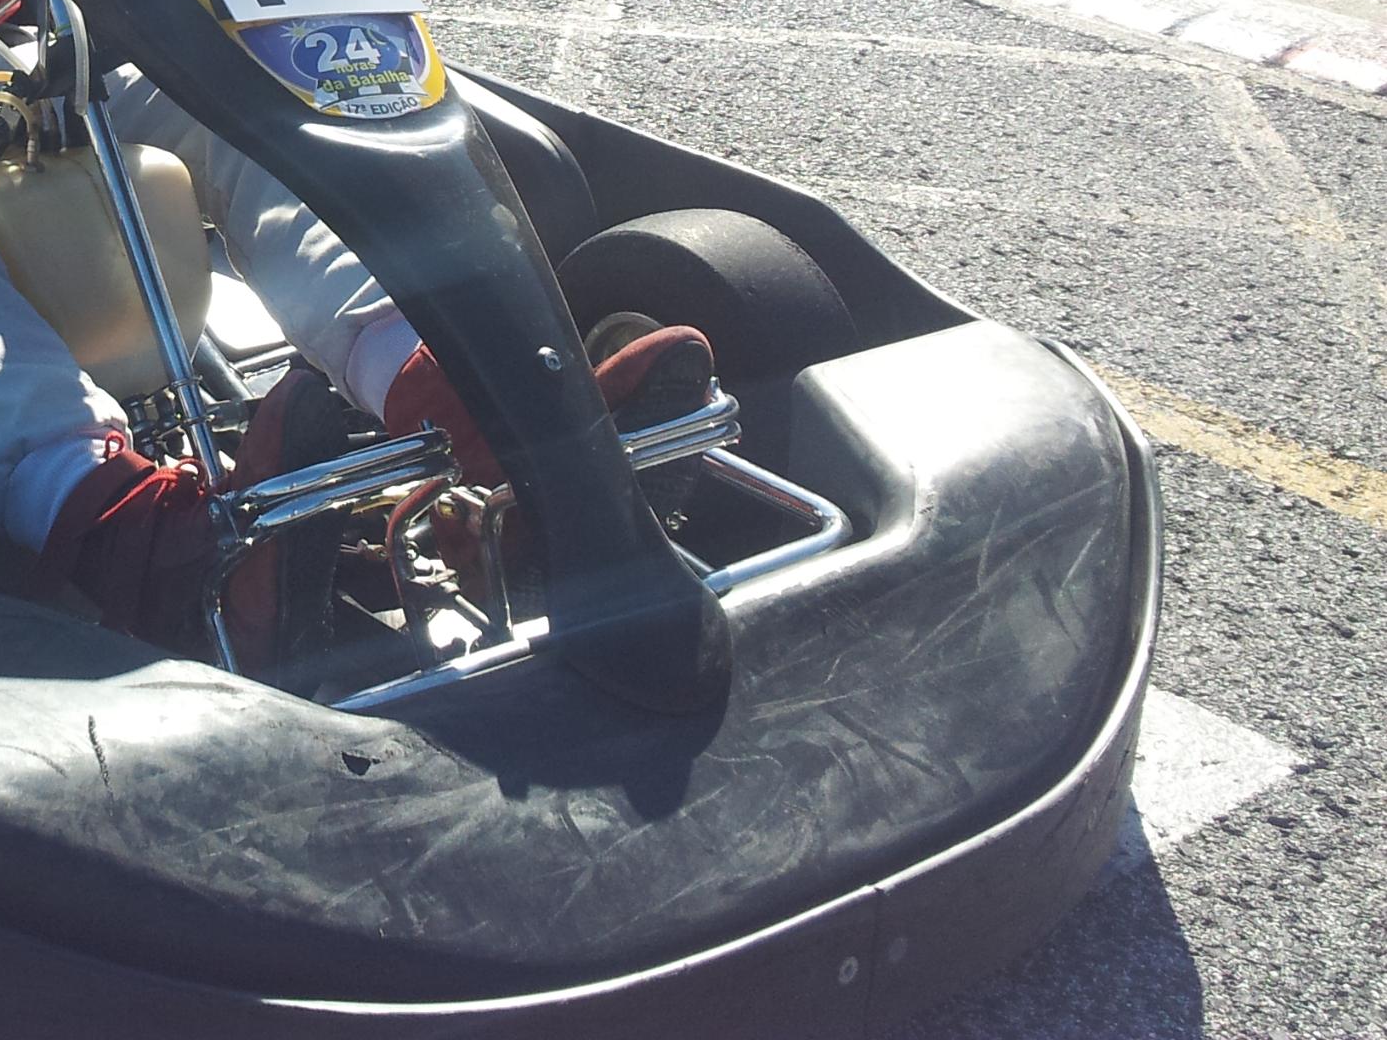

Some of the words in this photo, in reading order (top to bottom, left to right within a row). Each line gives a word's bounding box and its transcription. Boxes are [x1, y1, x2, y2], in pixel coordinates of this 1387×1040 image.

[304, 27, 382, 73] 24
[321, 79, 345, 92] da
[347, 69, 409, 88] Batalha
[372, 96, 419, 115] EDIÇÃO
